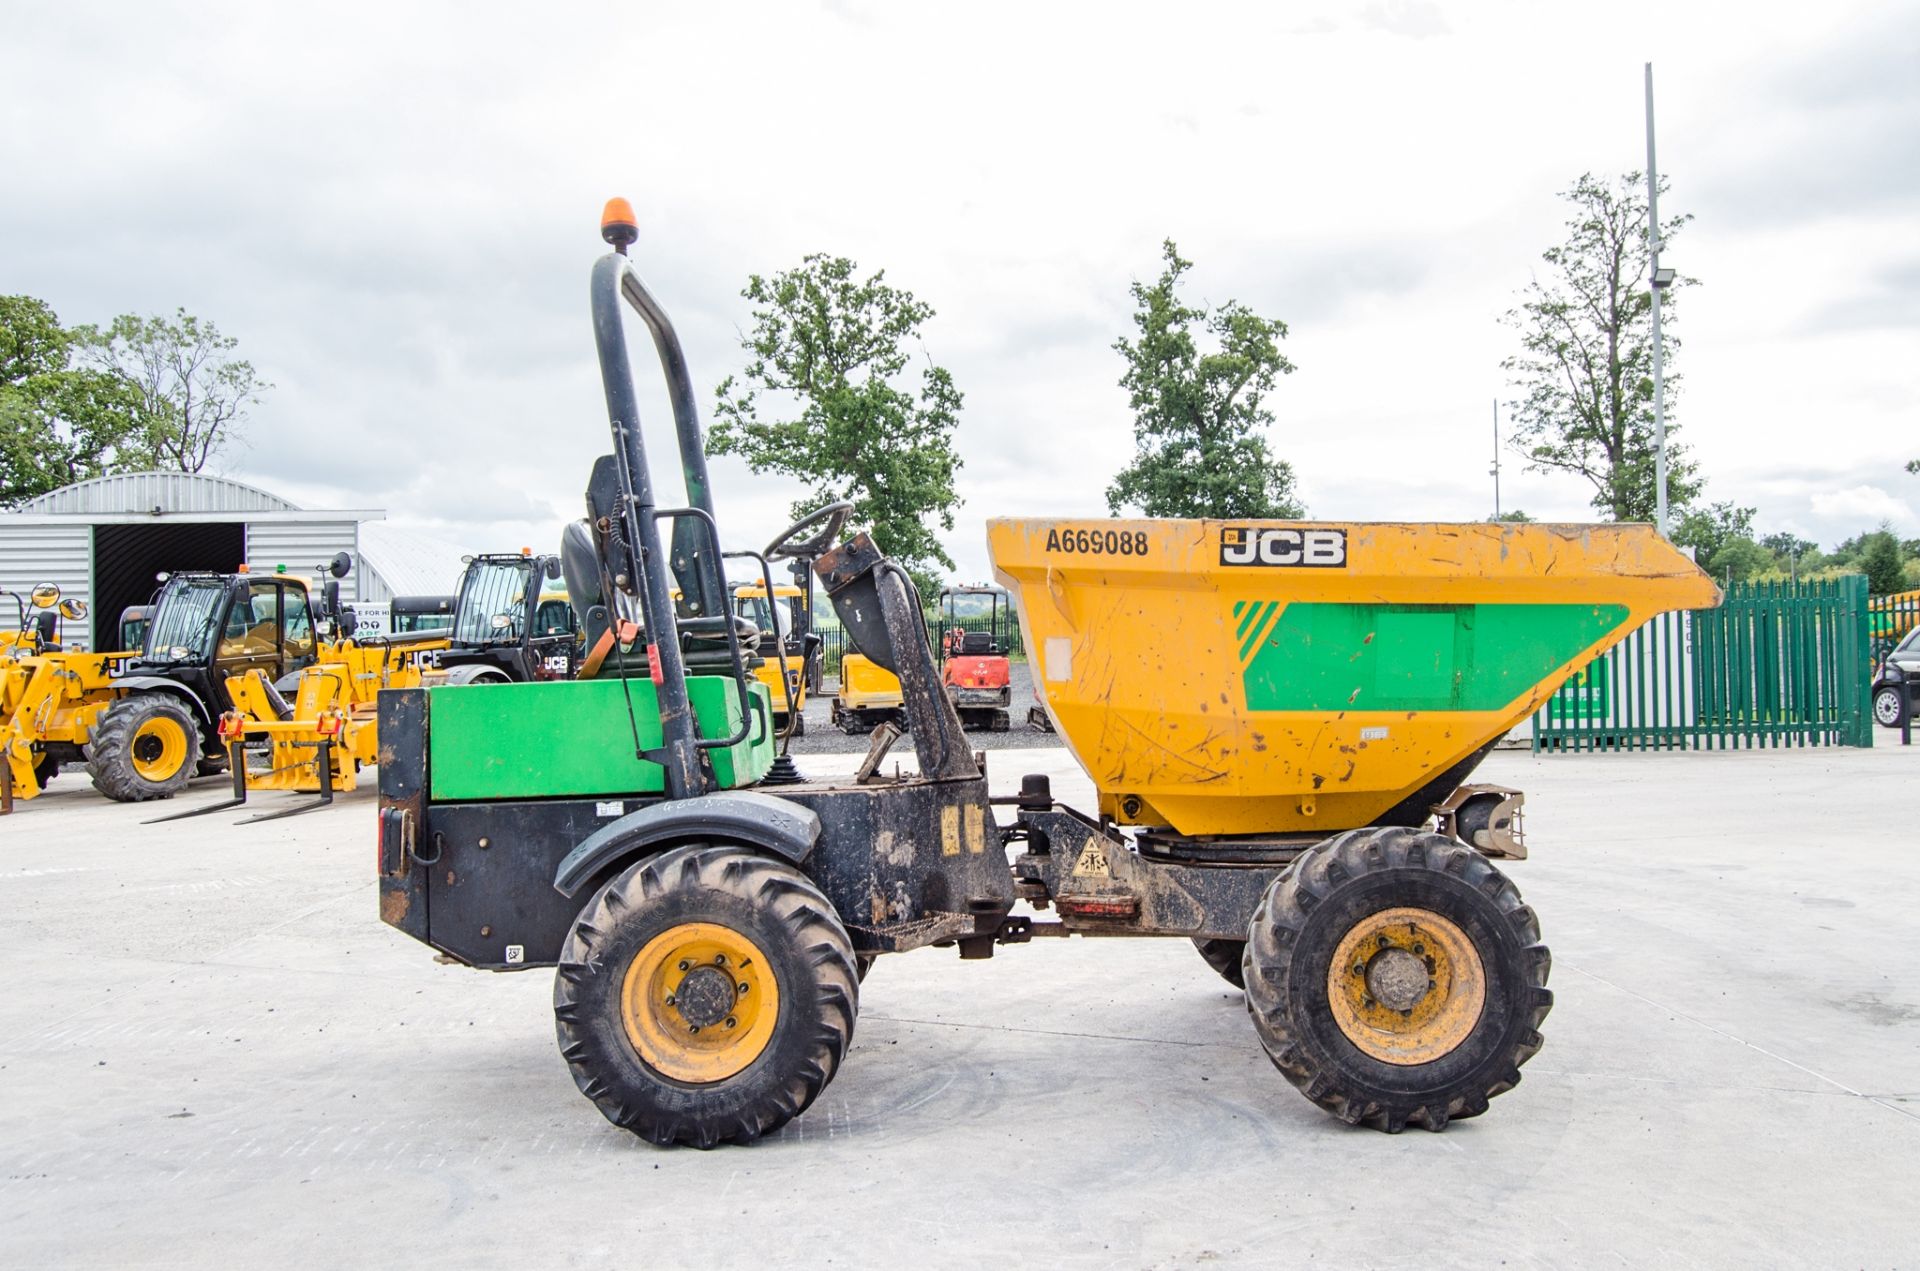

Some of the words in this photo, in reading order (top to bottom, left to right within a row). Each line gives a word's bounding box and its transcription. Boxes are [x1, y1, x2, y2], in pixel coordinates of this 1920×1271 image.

[1046, 529, 1149, 557] A669088
[1223, 530, 1345, 564] JCB
[109, 657, 143, 678] JC
[544, 656, 568, 670] JCB
